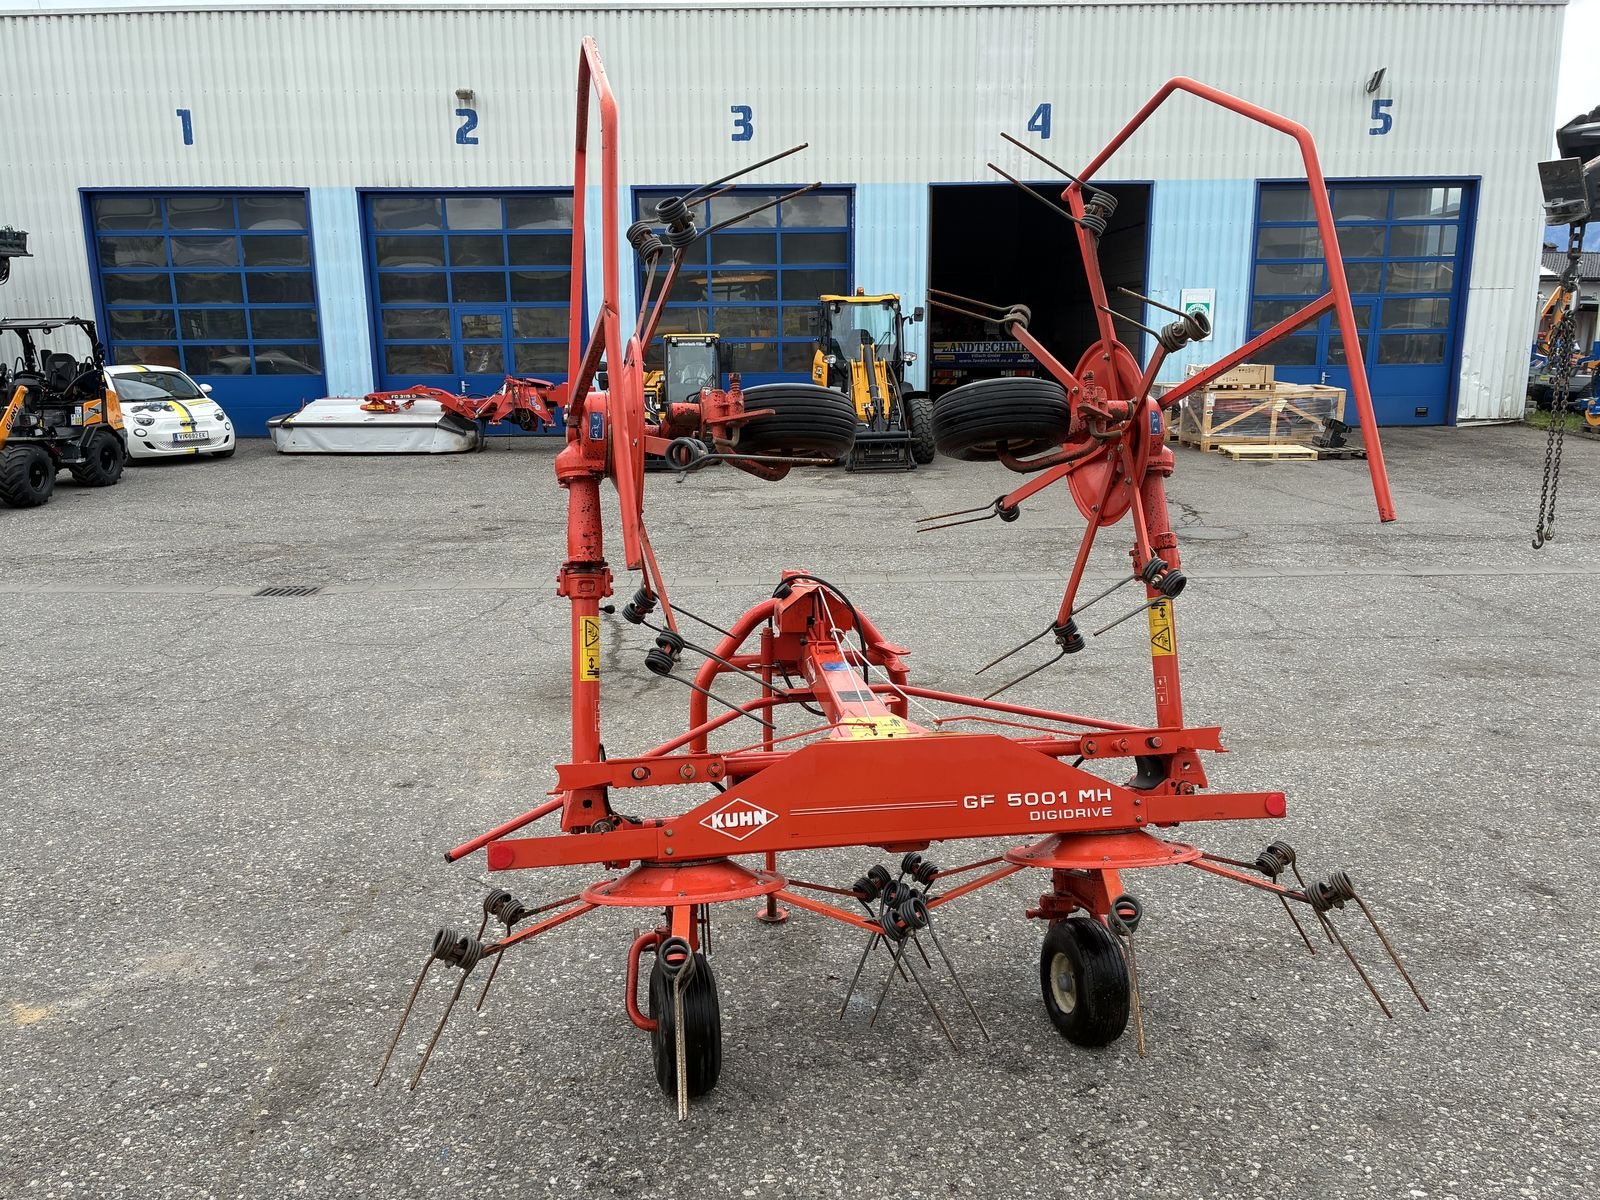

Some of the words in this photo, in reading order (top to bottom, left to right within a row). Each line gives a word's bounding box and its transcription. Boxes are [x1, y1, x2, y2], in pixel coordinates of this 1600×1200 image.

[177, 110, 192, 144] 1
[457, 109, 477, 144] 2
[732, 106, 752, 141] 3
[1028, 104, 1051, 138] 4
[1372, 100, 1391, 135] 5
[942, 342, 1026, 352] LANDTECHNI
[5, 403, 19, 431] GIANT
[963, 794, 995, 809] GF
[1007, 791, 1068, 806] 5001
[1078, 788, 1112, 803] MH
[1029, 806, 1113, 821] DIGIDRIVE
[711, 810, 767, 829] KUHN
